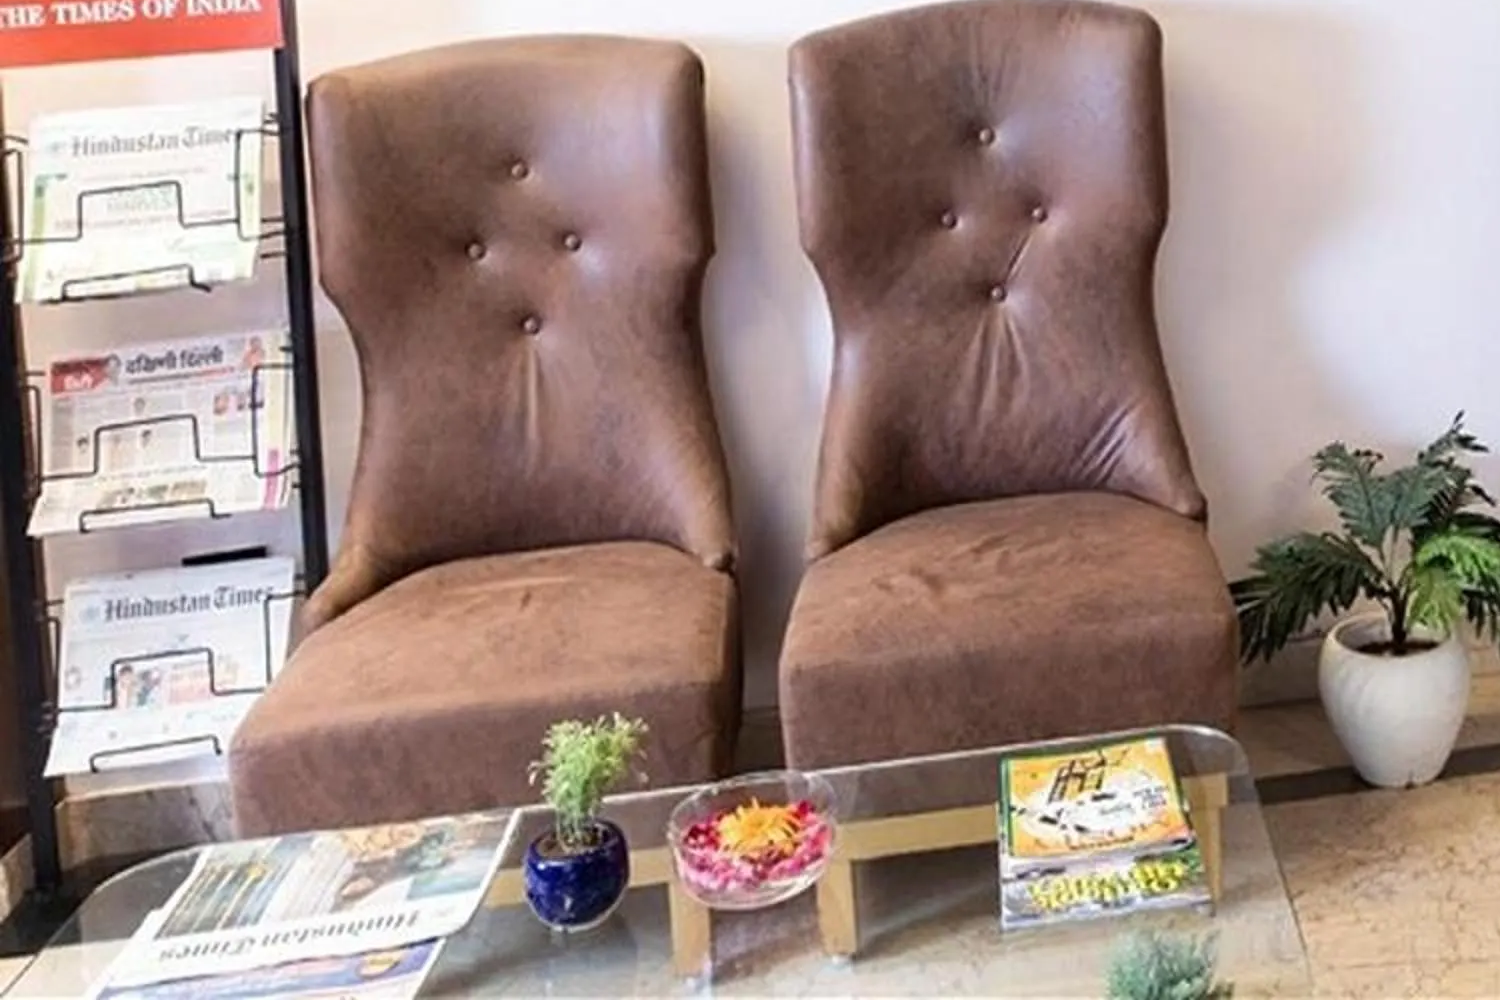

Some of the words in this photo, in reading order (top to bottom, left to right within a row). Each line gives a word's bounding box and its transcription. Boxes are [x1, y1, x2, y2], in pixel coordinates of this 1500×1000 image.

[71, 132, 179, 157] Hindustan
[183, 125, 236, 149] Time
[104, 594, 211, 622] Hindustan
[261, 909, 420, 944] Hindustan
[159, 935, 256, 961] Times
